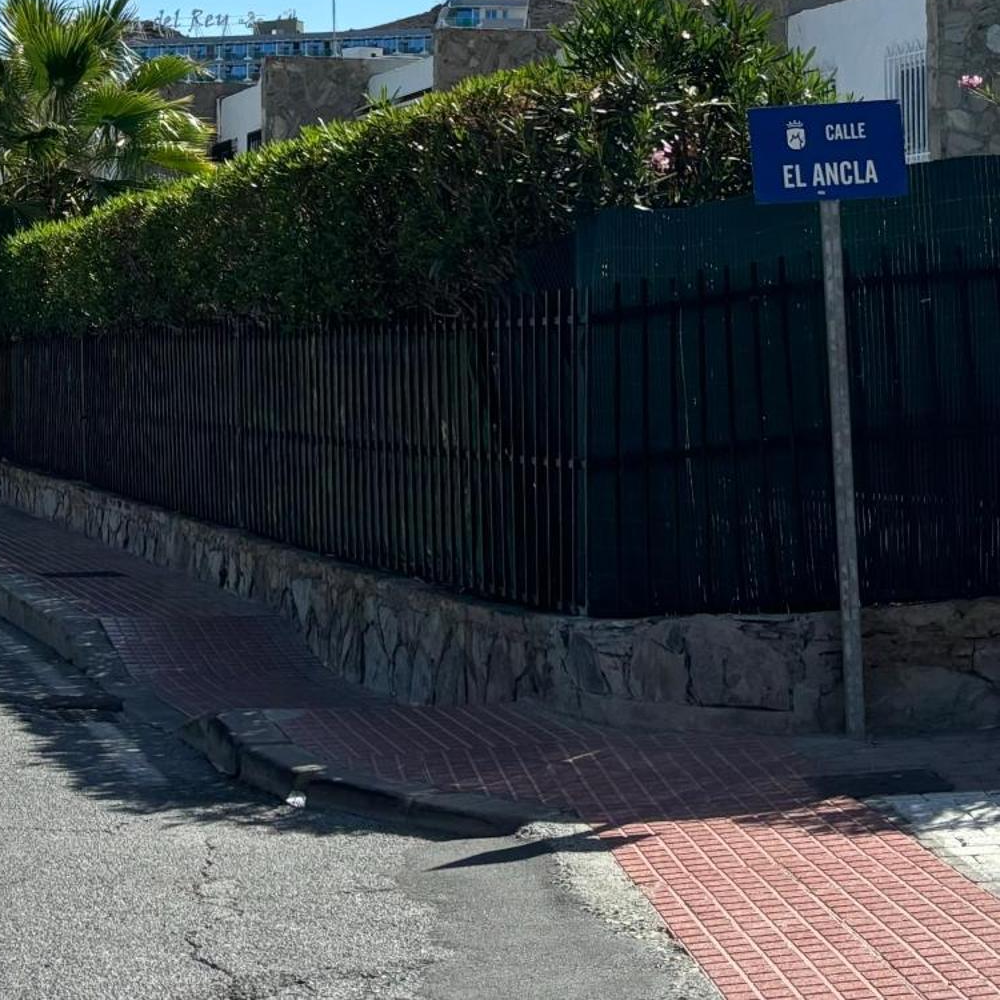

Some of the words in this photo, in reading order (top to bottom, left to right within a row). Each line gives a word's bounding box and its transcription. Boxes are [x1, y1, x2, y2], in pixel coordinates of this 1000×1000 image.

[188, 9, 229, 34] Rey
[825, 122, 867, 141] CALLE
[783, 164, 807, 189] EL
[812, 160, 879, 187] ANCLA
